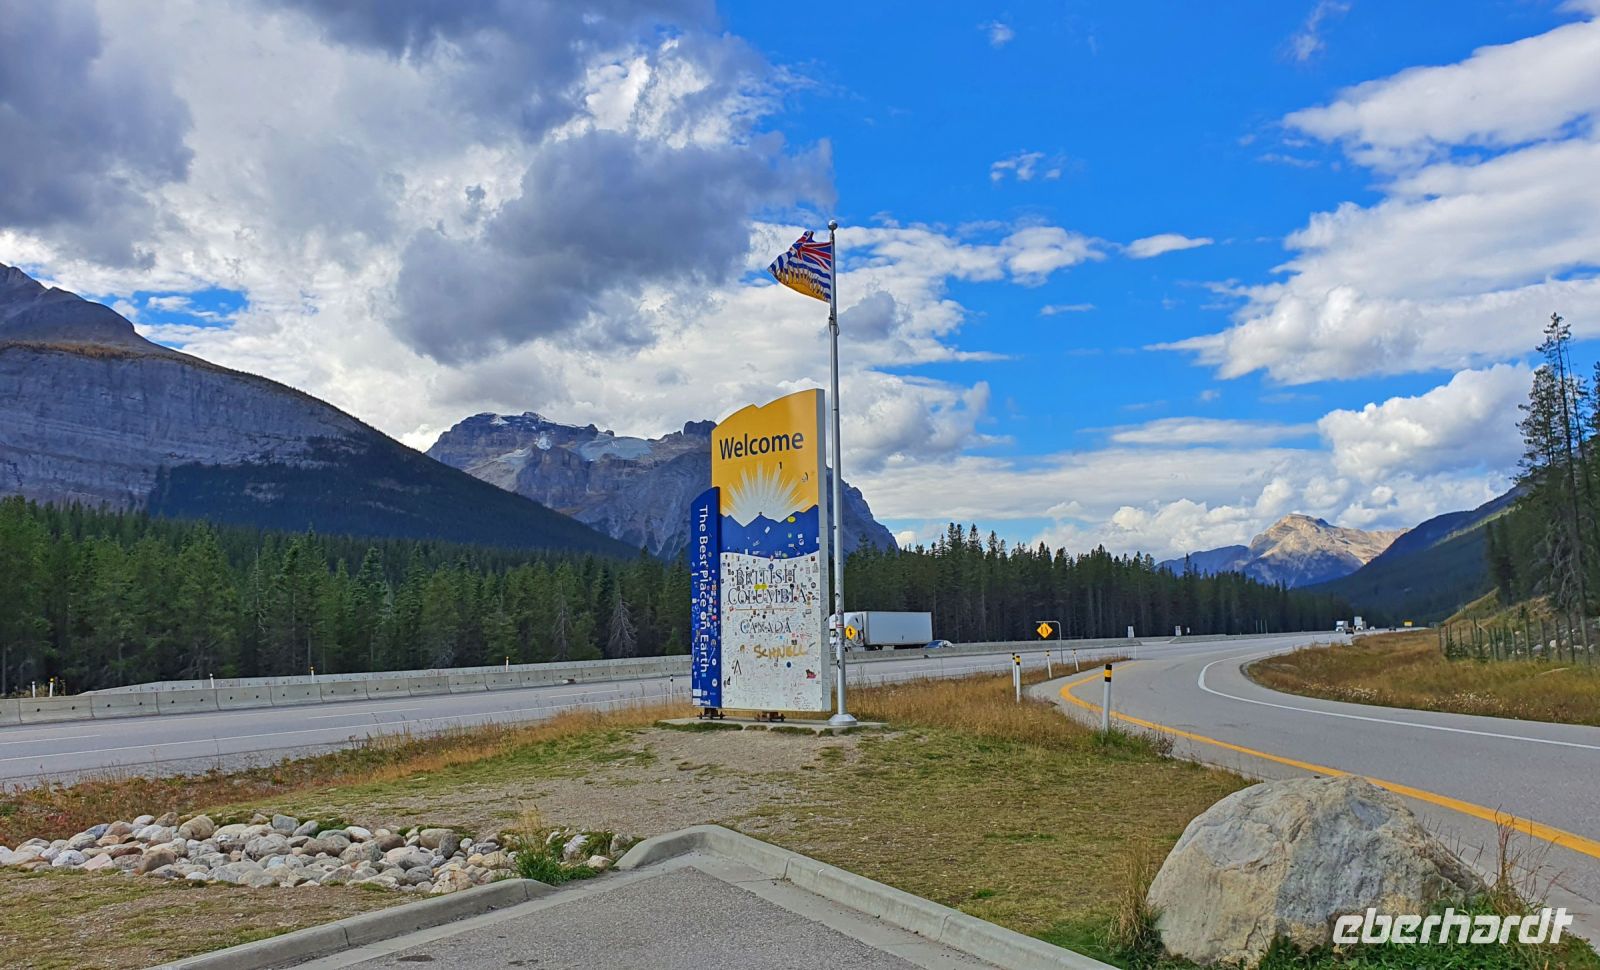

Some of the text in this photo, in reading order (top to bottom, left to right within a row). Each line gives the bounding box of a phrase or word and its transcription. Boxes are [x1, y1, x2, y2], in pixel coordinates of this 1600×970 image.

[719, 432, 804, 460] Welcome
[736, 566, 796, 586] BRITISH
[699, 504, 710, 672] The Best Place on Earth
[728, 587, 807, 605] COLUMBIA
[740, 618, 792, 634] CANADA
